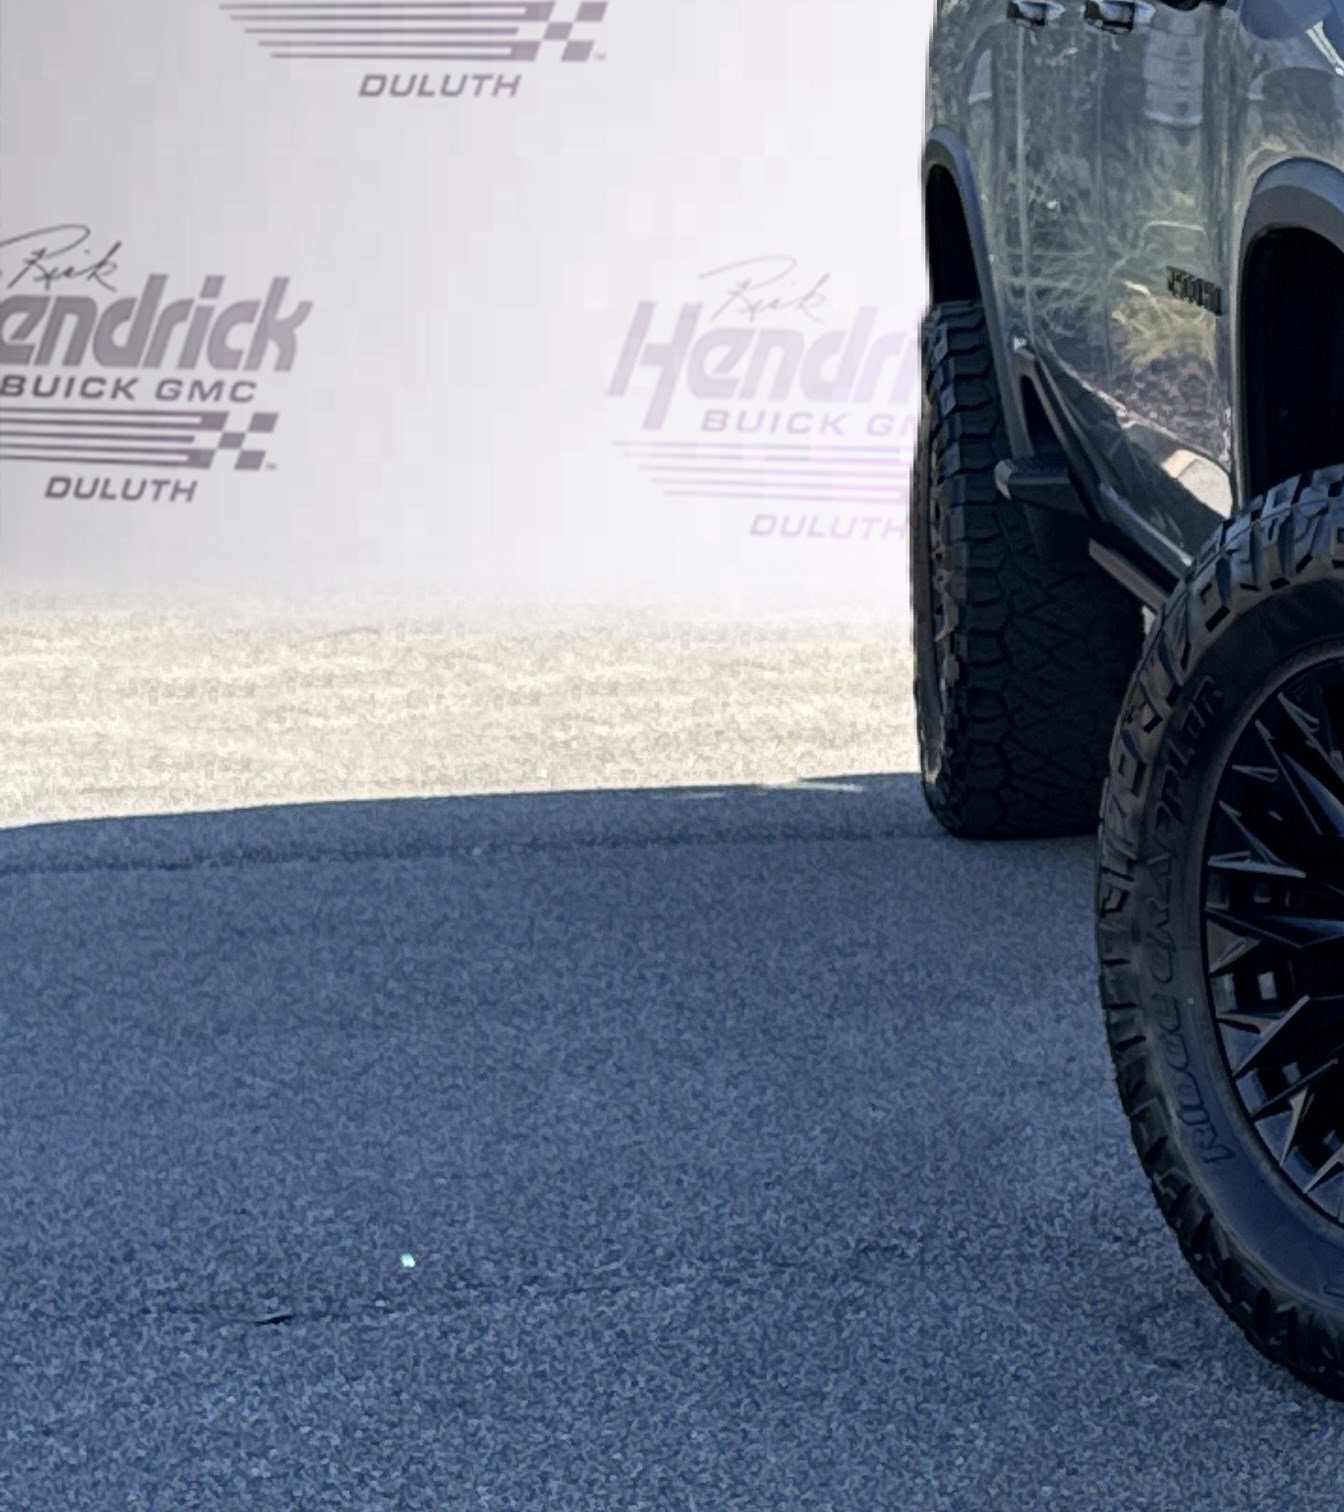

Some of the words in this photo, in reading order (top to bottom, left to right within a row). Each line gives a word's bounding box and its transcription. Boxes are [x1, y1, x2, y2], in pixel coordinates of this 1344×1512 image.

[358, 74, 522, 98] DULUTH
[0, 273, 313, 372] endrick
[607, 300, 922, 431] Hendri
[1, 374, 140, 401] BUICK
[155, 378, 258, 403] GMC
[700, 409, 847, 436] BUICK
[45, 476, 198, 503] DULUTH
[750, 514, 908, 541] DULUTH
[1152, 995, 1234, 1164] RIDGE
